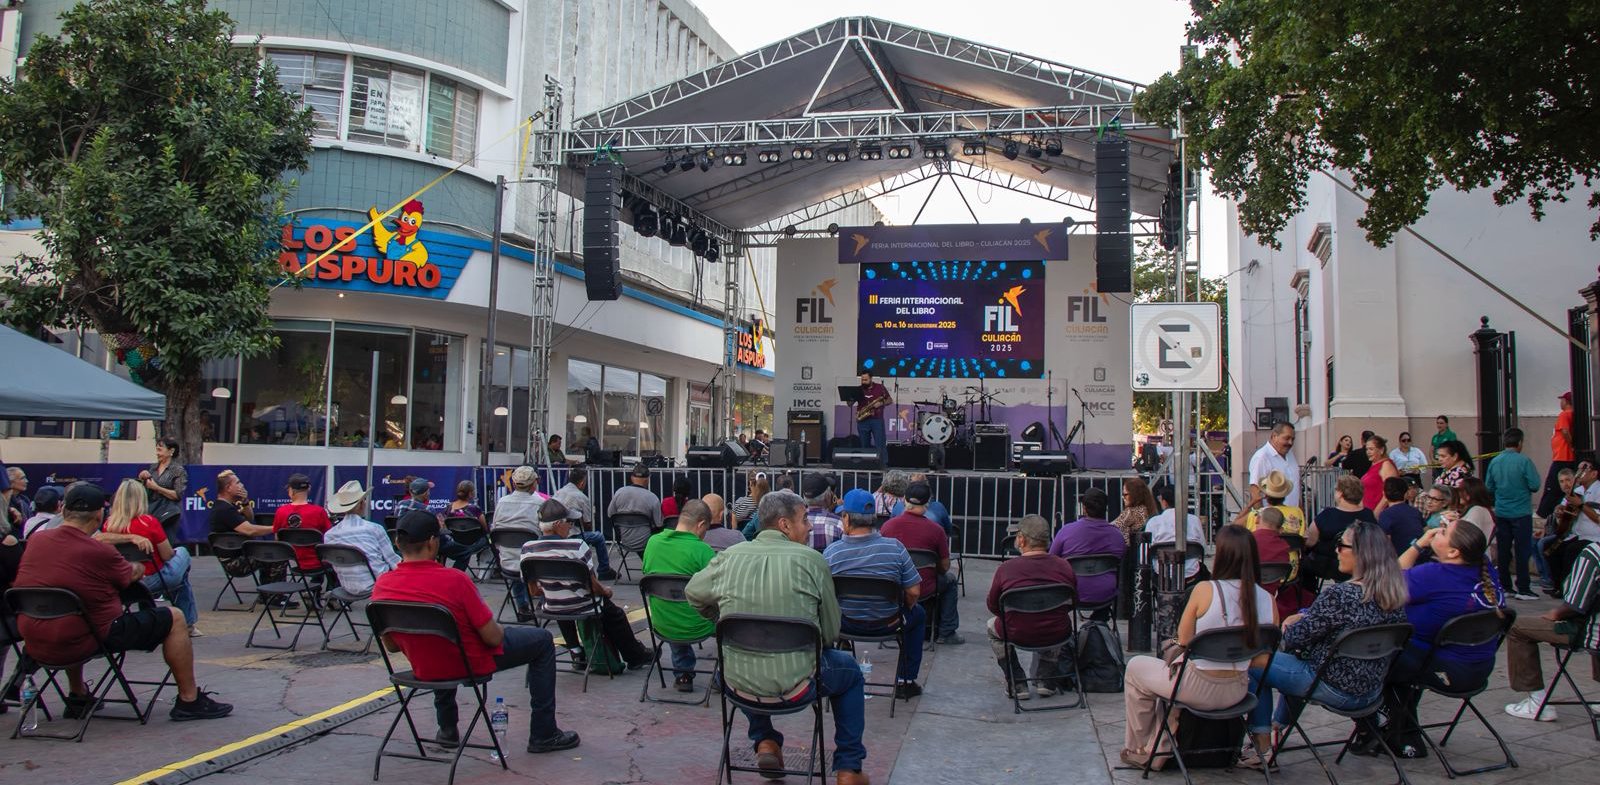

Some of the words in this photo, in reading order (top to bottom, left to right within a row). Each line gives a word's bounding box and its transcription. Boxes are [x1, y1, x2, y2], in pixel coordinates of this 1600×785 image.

[370, 89, 383, 99] EN
[281, 223, 357, 252] LOS
[871, 242, 889, 250] FERIA
[890, 241, 940, 249] INTERNACIONAL
[955, 240, 975, 248] LIBRO
[1013, 239, 1031, 247] 2025
[277, 252, 442, 289] AISPURO
[869, 294, 878, 304] III
[879, 297, 901, 305] FERIA
[902, 296, 964, 305] INTERNACIONAL
[796, 292, 833, 323] FIL
[896, 307, 910, 315] DEL
[912, 307, 936, 315] LIBRO
[1067, 292, 1107, 323] FIL
[984, 299, 1019, 332] FIL
[884, 320, 892, 329] 10
[899, 320, 907, 329] 16
[938, 320, 957, 329] 2025
[738, 331, 754, 350] LOS
[981, 332, 1022, 342] CULIACÁN
[990, 344, 1012, 352] 2025
[793, 399, 822, 408] IMCC
[185, 494, 206, 511] FIL
